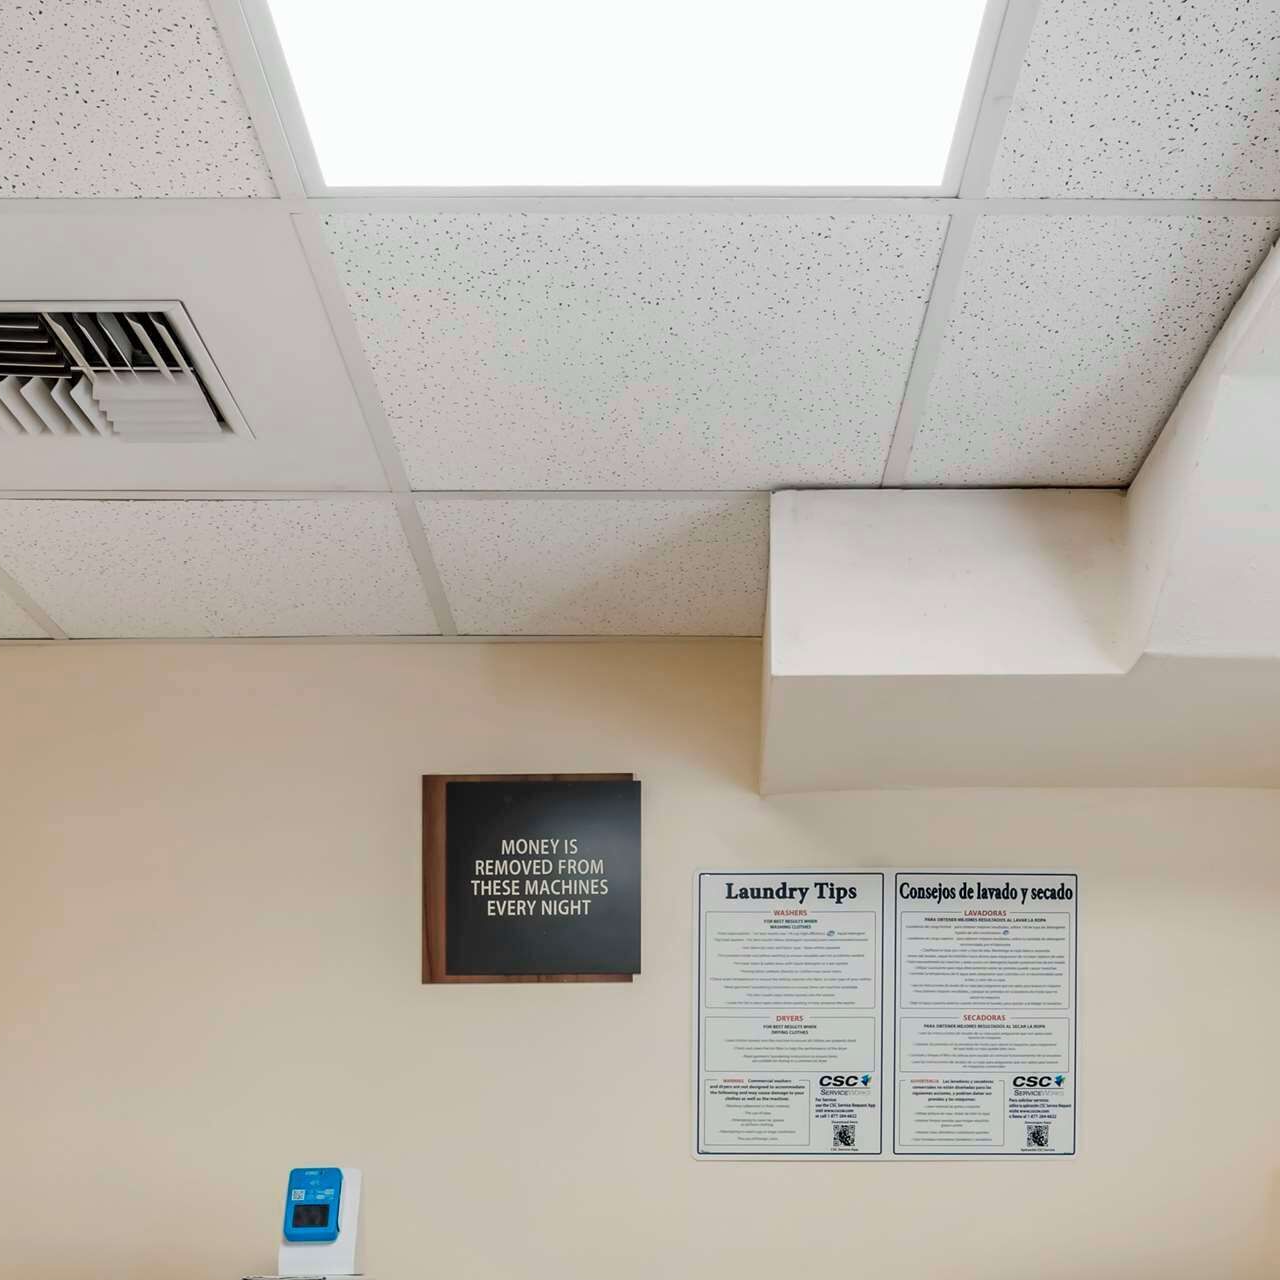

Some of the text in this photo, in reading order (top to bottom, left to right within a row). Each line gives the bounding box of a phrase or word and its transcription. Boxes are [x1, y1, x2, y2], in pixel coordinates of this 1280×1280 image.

[501, 839, 578, 855] MONEY IS
[475, 859, 604, 875] REMOVED FROM
[471, 879, 609, 896] THESE MACHINES
[725, 882, 857, 904] Laundry Tips
[900, 882, 1073, 904] Consejos de lavado y secado
[487, 900, 591, 916] EVERY NIGHT
[819, 1075, 859, 1087] CSC
[1013, 1076, 1052, 1087] CSC
